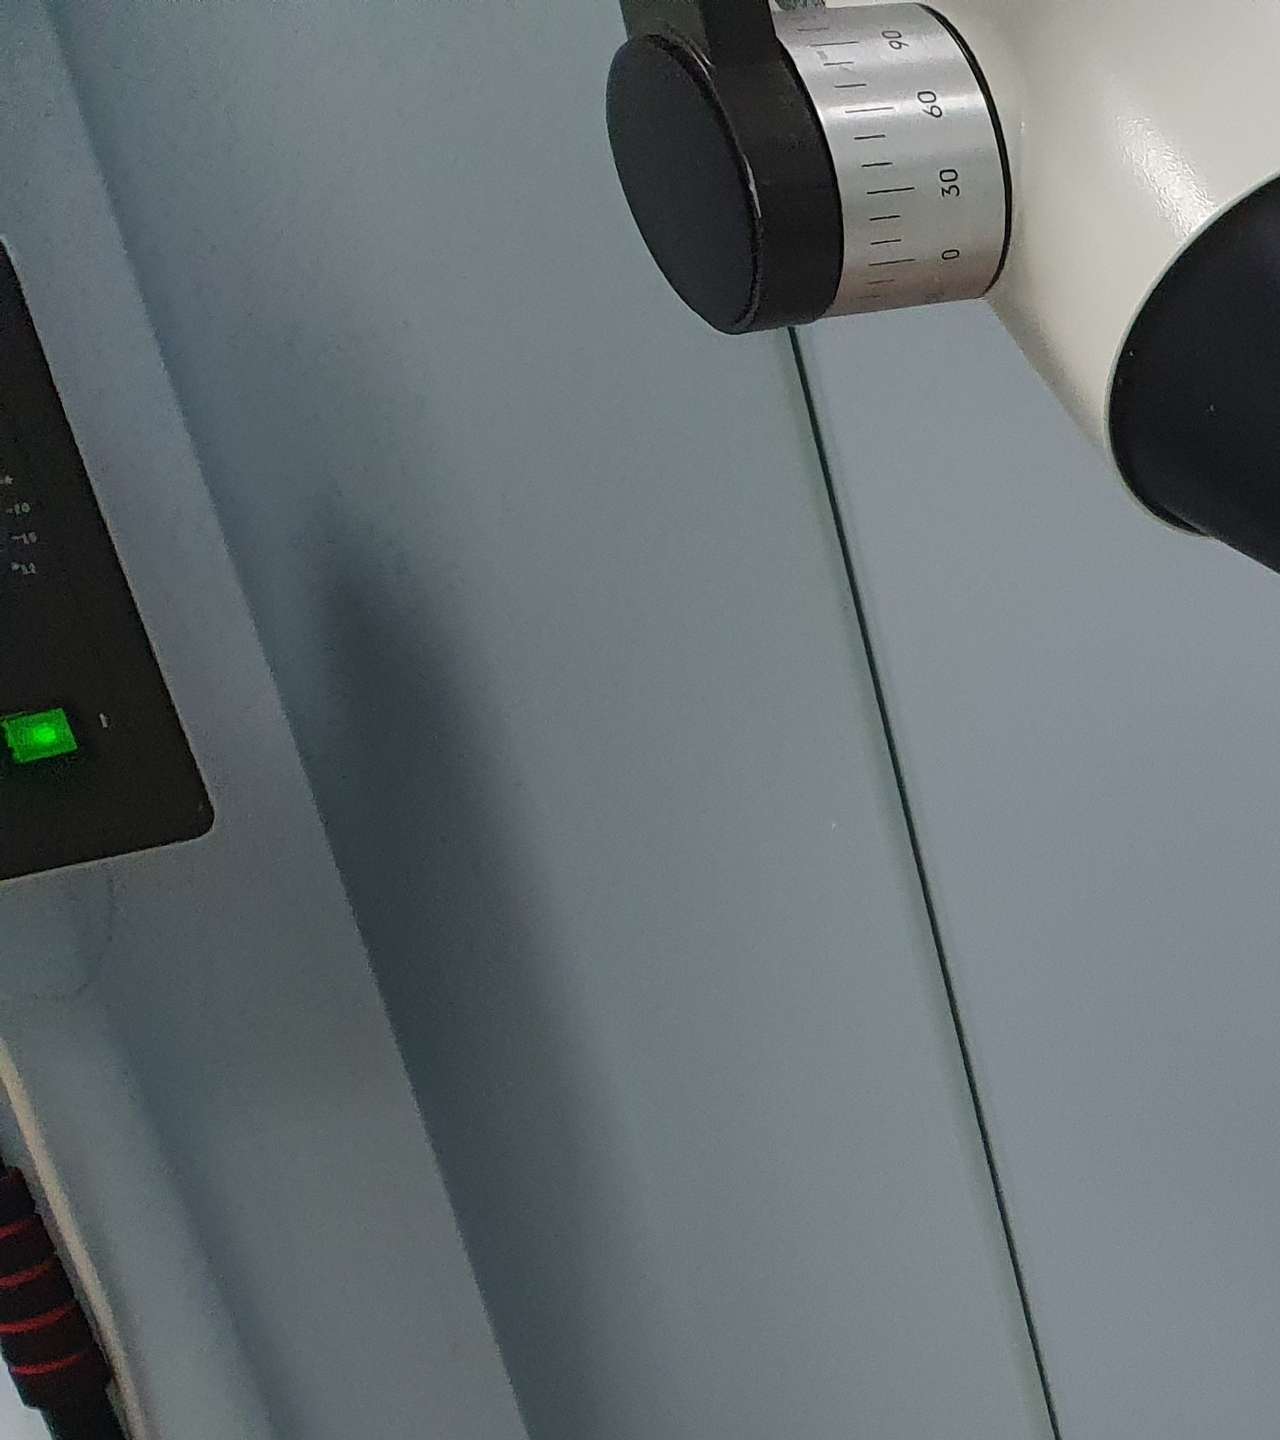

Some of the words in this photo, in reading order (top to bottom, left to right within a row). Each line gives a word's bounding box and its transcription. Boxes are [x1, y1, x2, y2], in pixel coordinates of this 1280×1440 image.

[881, 29, 910, 51] 90
[917, 90, 943, 119] 60
[939, 168, 960, 198] 30
